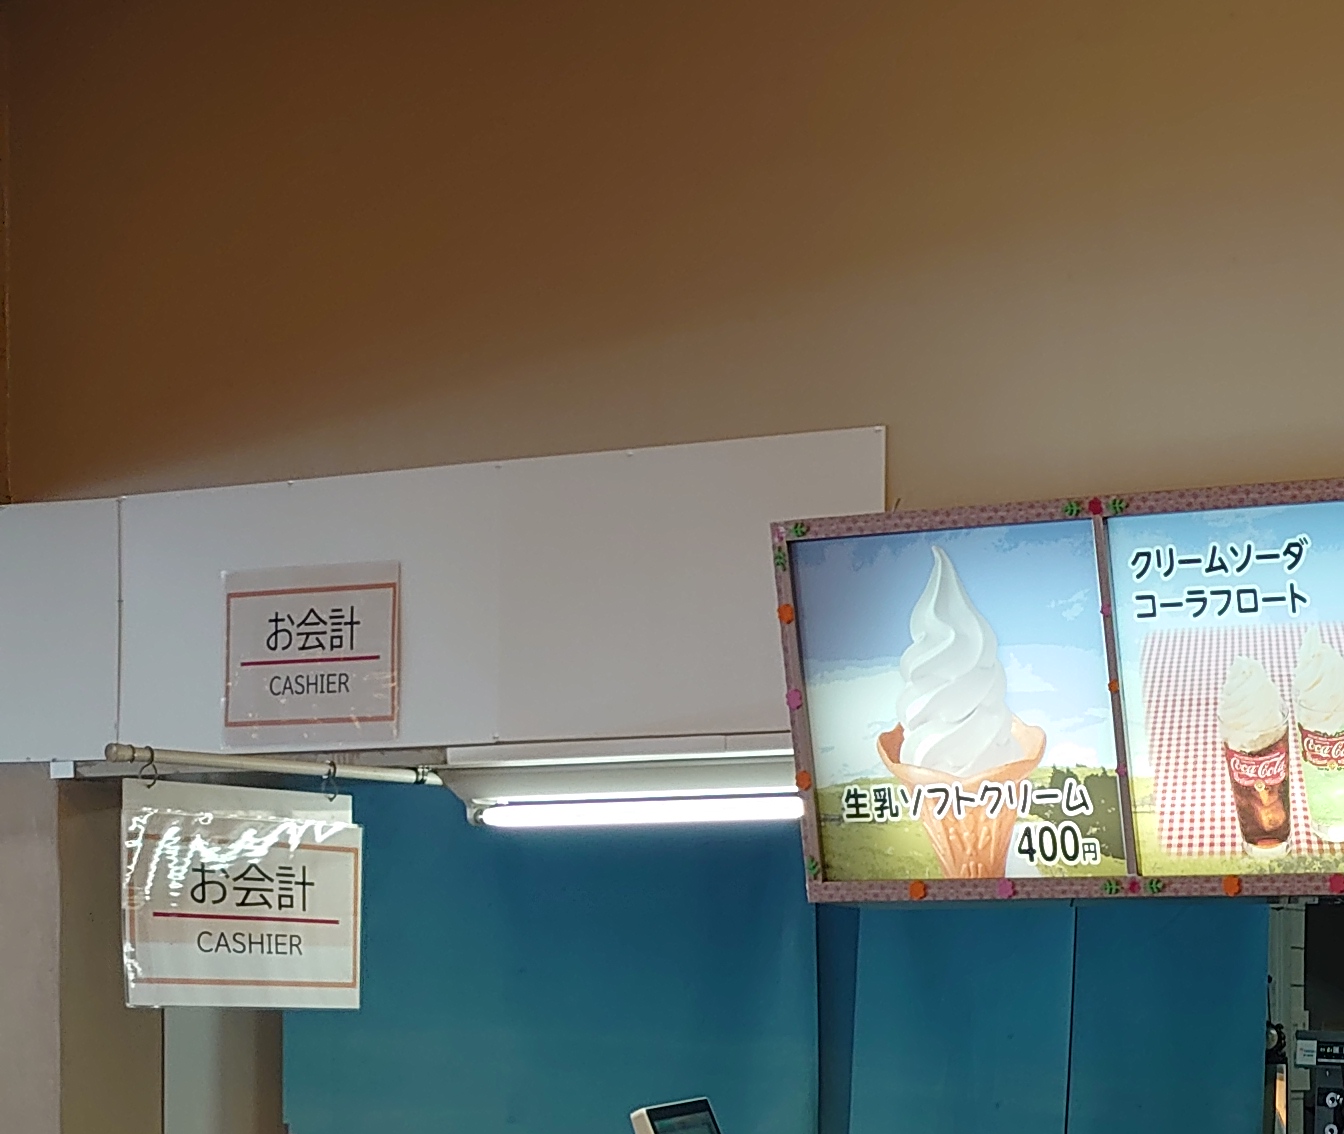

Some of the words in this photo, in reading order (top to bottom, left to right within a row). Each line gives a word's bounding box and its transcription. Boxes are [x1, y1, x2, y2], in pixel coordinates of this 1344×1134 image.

[1131, 536, 1309, 580] クリームソーダ
[1135, 584, 1308, 618] コーラフロート
[266, 606, 361, 651] お会計
[269, 673, 350, 696] CASHIER
[844, 782, 1092, 821] 生乳ソフトクリーム
[1018, 825, 1098, 863] 400円
[189, 863, 315, 911] お会計
[197, 931, 303, 956] CASHIER
